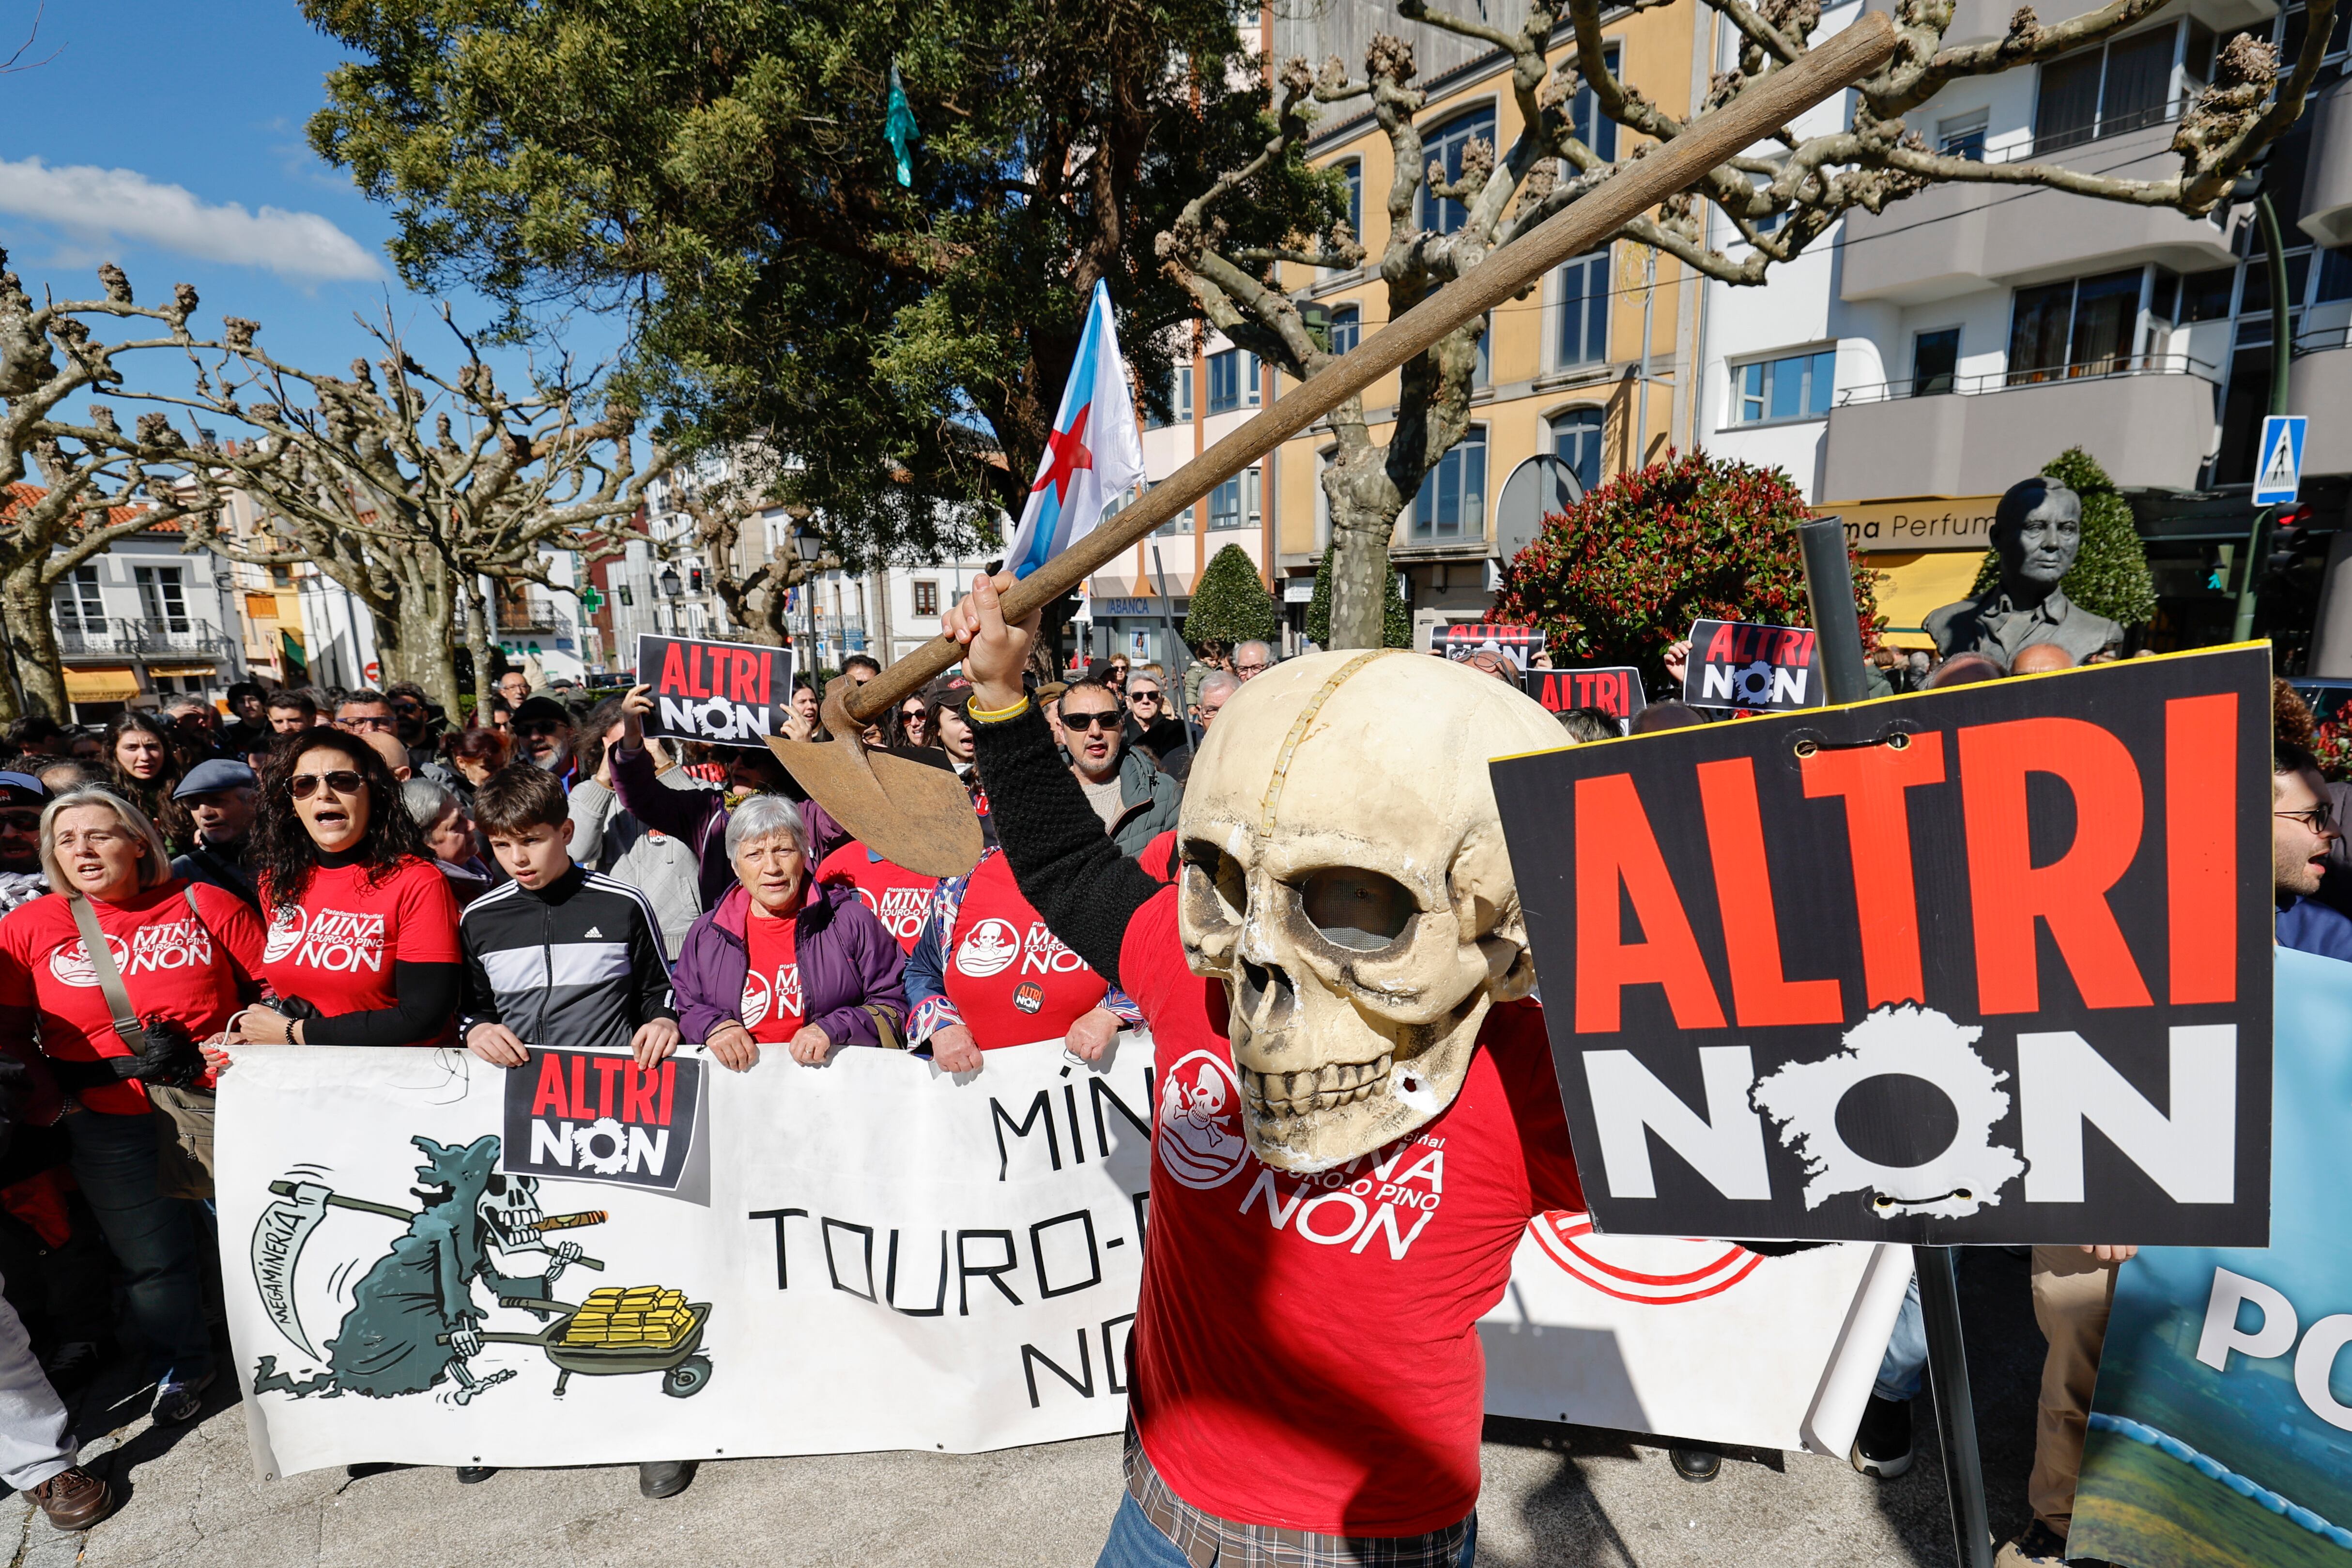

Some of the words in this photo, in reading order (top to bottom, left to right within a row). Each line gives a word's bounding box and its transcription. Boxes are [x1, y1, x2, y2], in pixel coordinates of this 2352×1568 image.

[1706, 624, 1815, 666] ALTRI
[659, 642, 772, 704] ALTRI
[1702, 660, 1808, 705] NON
[659, 695, 771, 740] NON
[1575, 692, 2238, 1033] ALTRI
[321, 908, 358, 918] Plataforma
[880, 892, 930, 909] MIN
[132, 922, 209, 949] MINA
[138, 922, 180, 931] Plataforma
[305, 933, 354, 946] TOURO-O
[354, 938, 384, 947] PINO
[308, 914, 385, 938] MINA
[130, 945, 212, 975] NON
[133, 938, 183, 956] TOURO-O
[295, 941, 383, 972] NON
[1016, 995, 1040, 1010] NON
[1019, 985, 1042, 1001] ALTRI
[531, 1053, 676, 1125] ALTRI
[1583, 1000, 2236, 1219] NON
[529, 1116, 669, 1176] NON
[1375, 1184, 1440, 1211] PINO
[1239, 1168, 1434, 1260] NON
